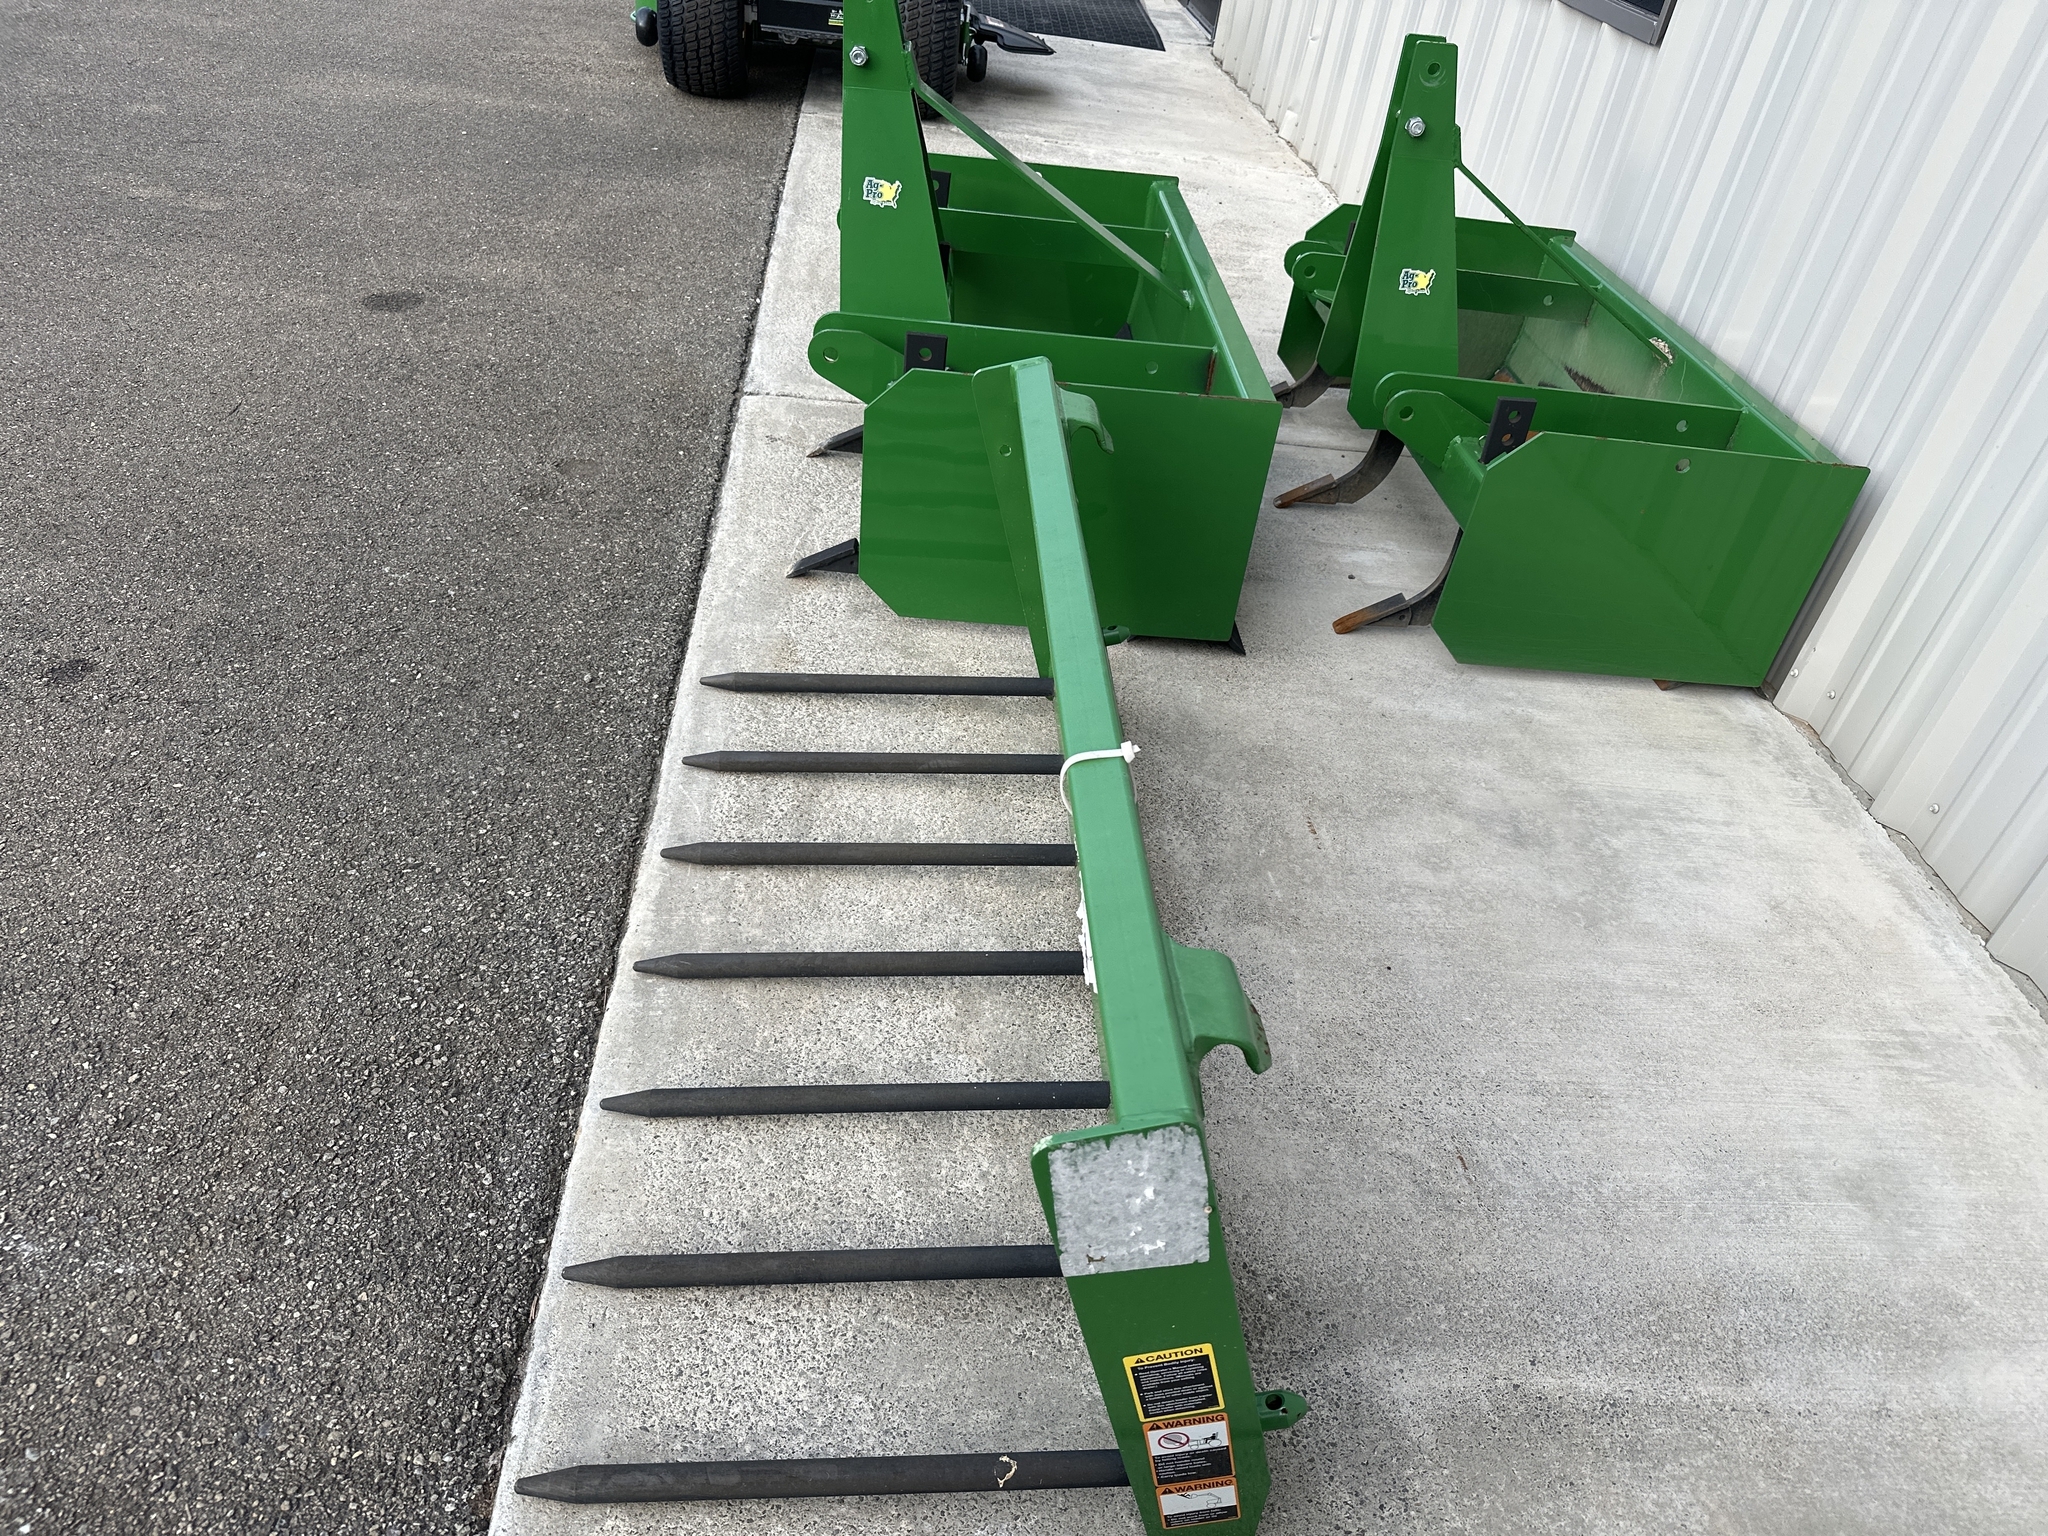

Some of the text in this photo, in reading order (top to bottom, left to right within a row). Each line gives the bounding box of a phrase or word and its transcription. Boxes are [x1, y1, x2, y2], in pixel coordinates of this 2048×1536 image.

[866, 189, 883, 198] Pro
[1401, 280, 1417, 288] Pro
[1145, 1347, 1203, 1363] CAUTION
[1162, 1414, 1225, 1429] WARNING
[1174, 1479, 1234, 1493] WARNING
